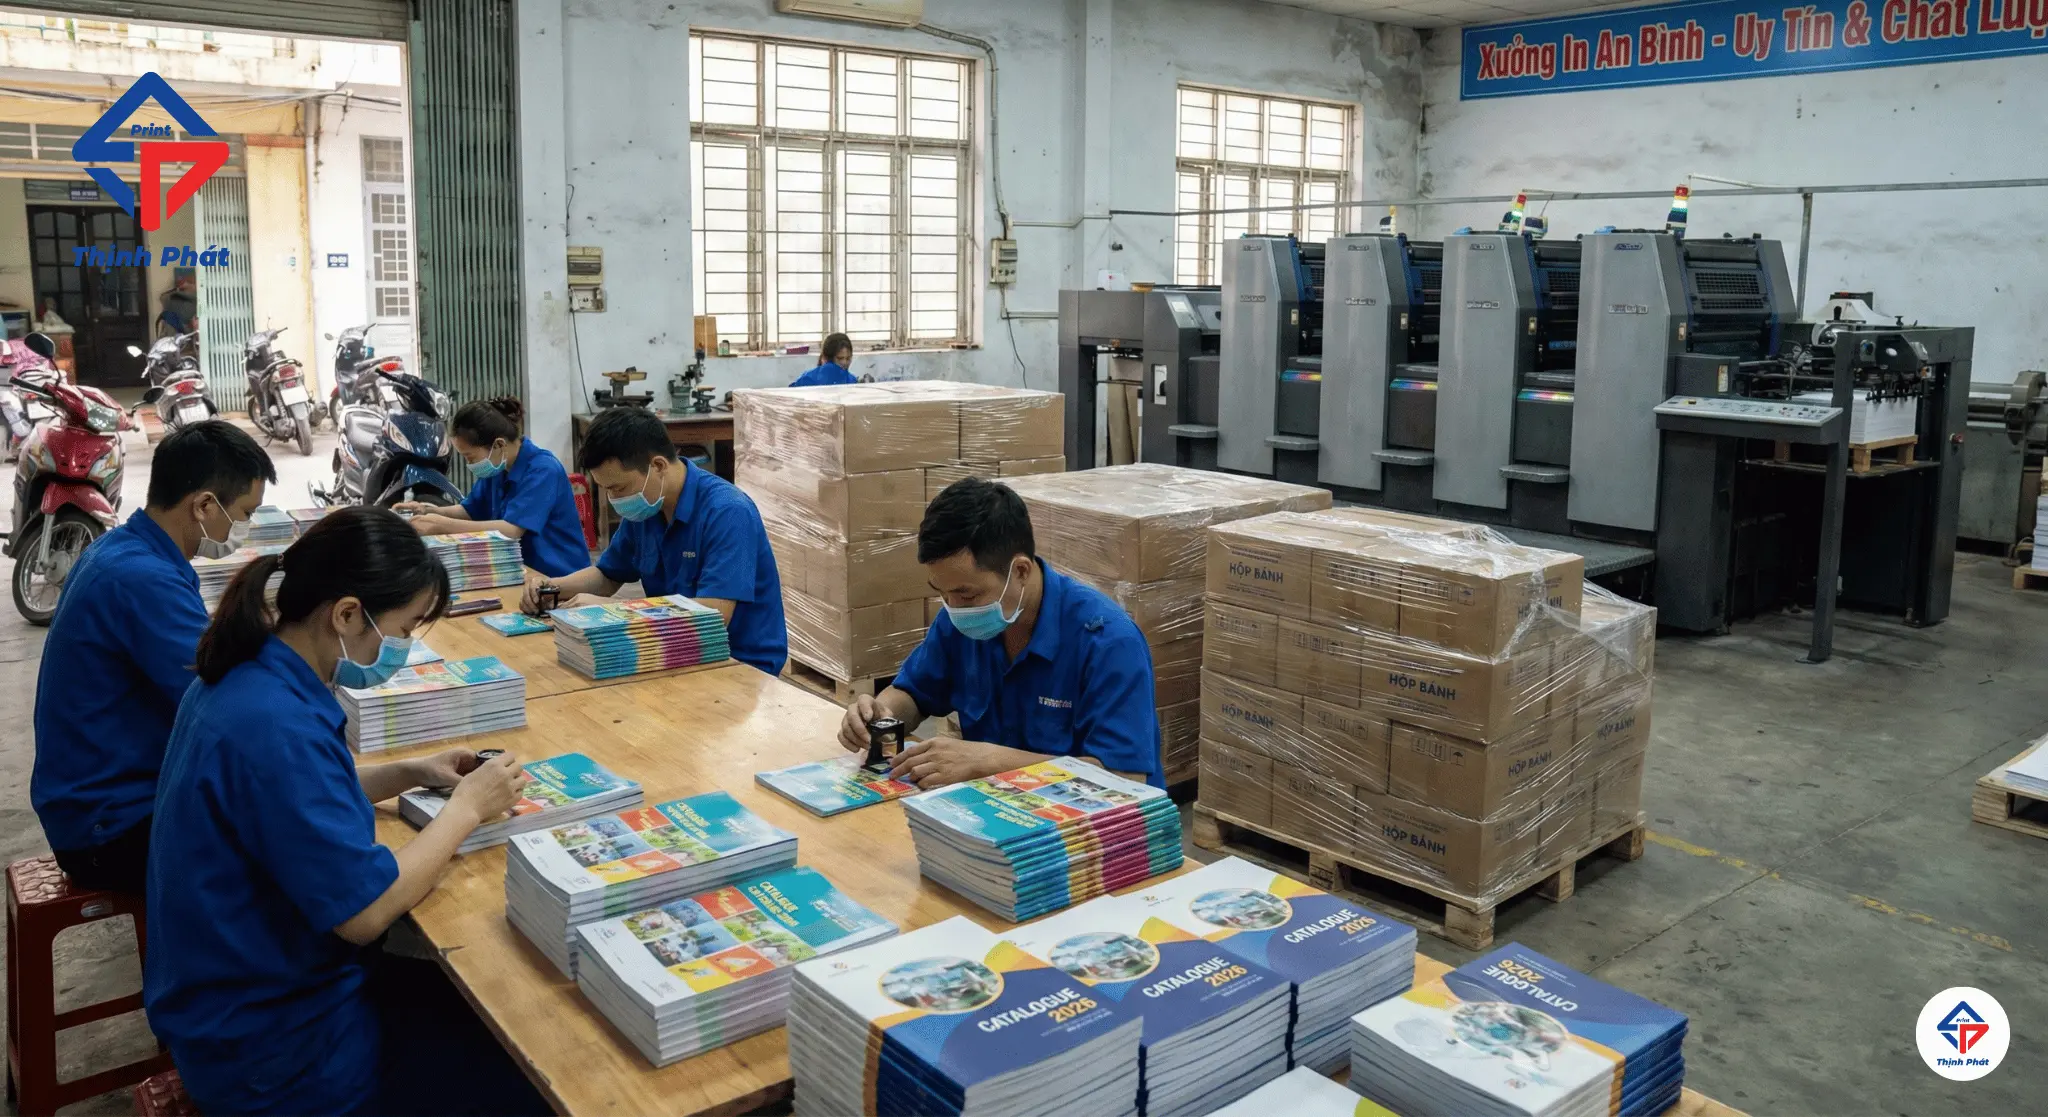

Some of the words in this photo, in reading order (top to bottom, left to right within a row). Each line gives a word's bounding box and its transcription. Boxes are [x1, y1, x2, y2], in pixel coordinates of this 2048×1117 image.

[1477, 33, 1556, 80] Xưởng
[1562, 34, 1588, 72] In
[1594, 28, 1632, 68] An
[1638, 19, 1704, 66] Bình
[1711, 35, 1726, 46] -
[1733, 12, 1776, 61] Uy
[1783, 6, 1834, 52] Tín
[1842, 0, 1873, 47] &
[1229, 562, 1252, 579] HỘP
[1254, 566, 1284, 584] BÁNH
[1389, 672, 1416, 690] HỘP
[1419, 681, 1456, 700] BÁNH
[1382, 824, 1407, 841] HỘP
[1410, 834, 1446, 856] BÁNH
[1283, 908, 1359, 944] CATALOGUE
[1339, 916, 1378, 935] 2026
[1142, 956, 1231, 998] CATALOGUE
[1204, 964, 1248, 988] 2026
[1498, 959, 1545, 983] 2026
[977, 987, 1081, 1033] CATALOGUE
[1048, 996, 1098, 1023] 2026
